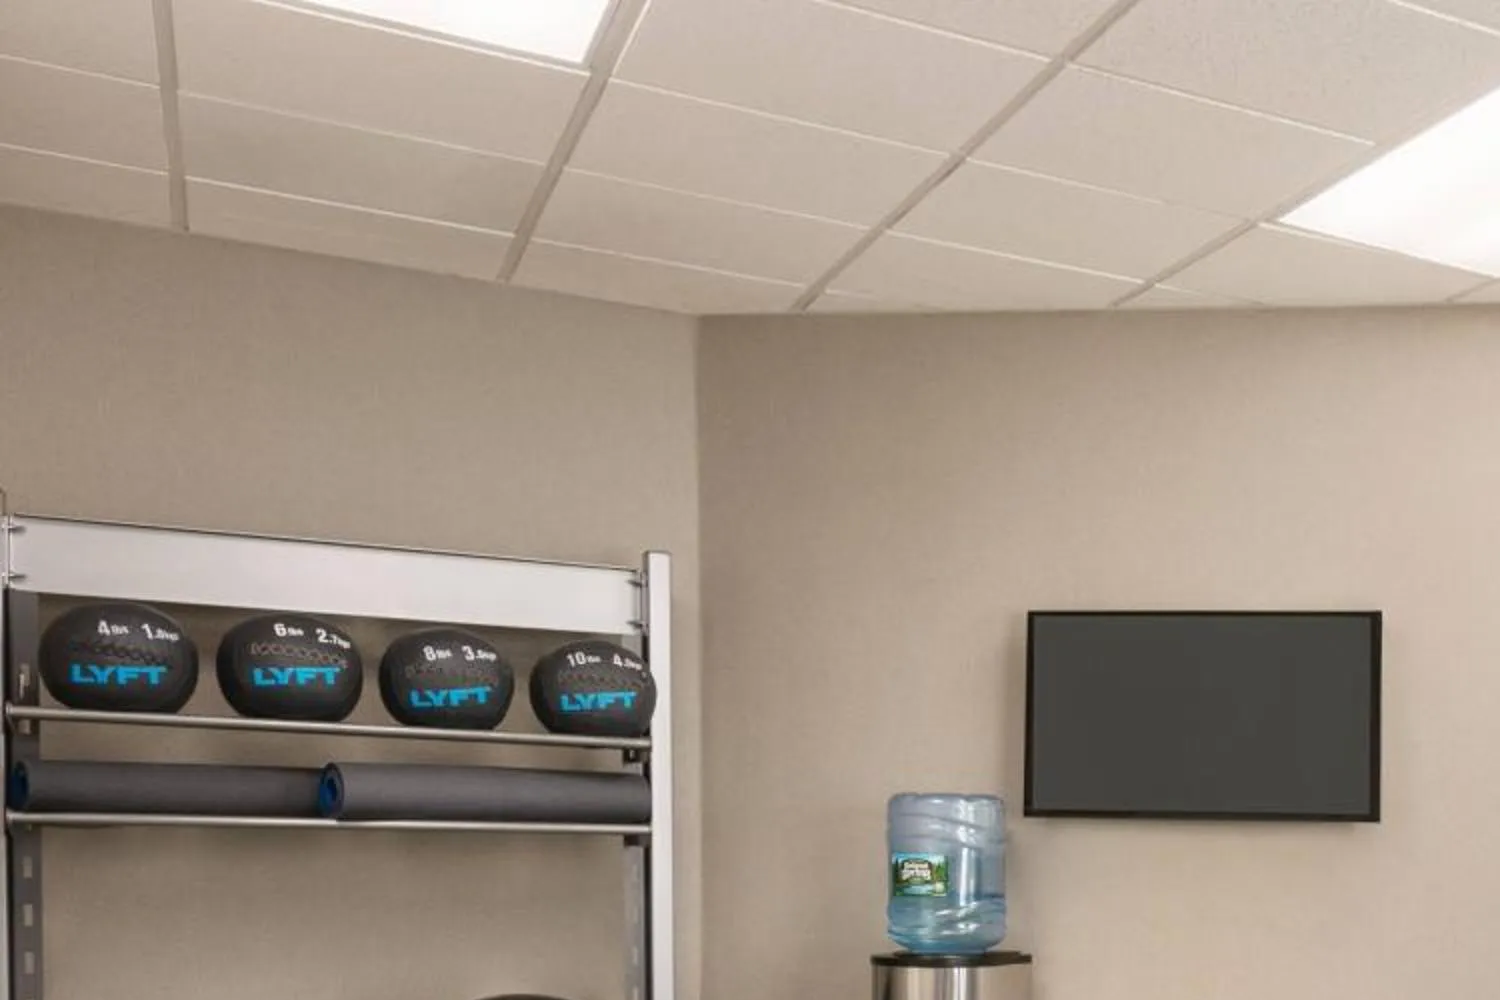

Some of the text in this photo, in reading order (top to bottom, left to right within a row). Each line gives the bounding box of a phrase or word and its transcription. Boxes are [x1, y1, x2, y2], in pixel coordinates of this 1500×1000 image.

[70, 664, 168, 686] LYFT
[253, 667, 341, 687] LYFT
[411, 686, 492, 708] LYFT
[561, 691, 637, 711] LYFT
